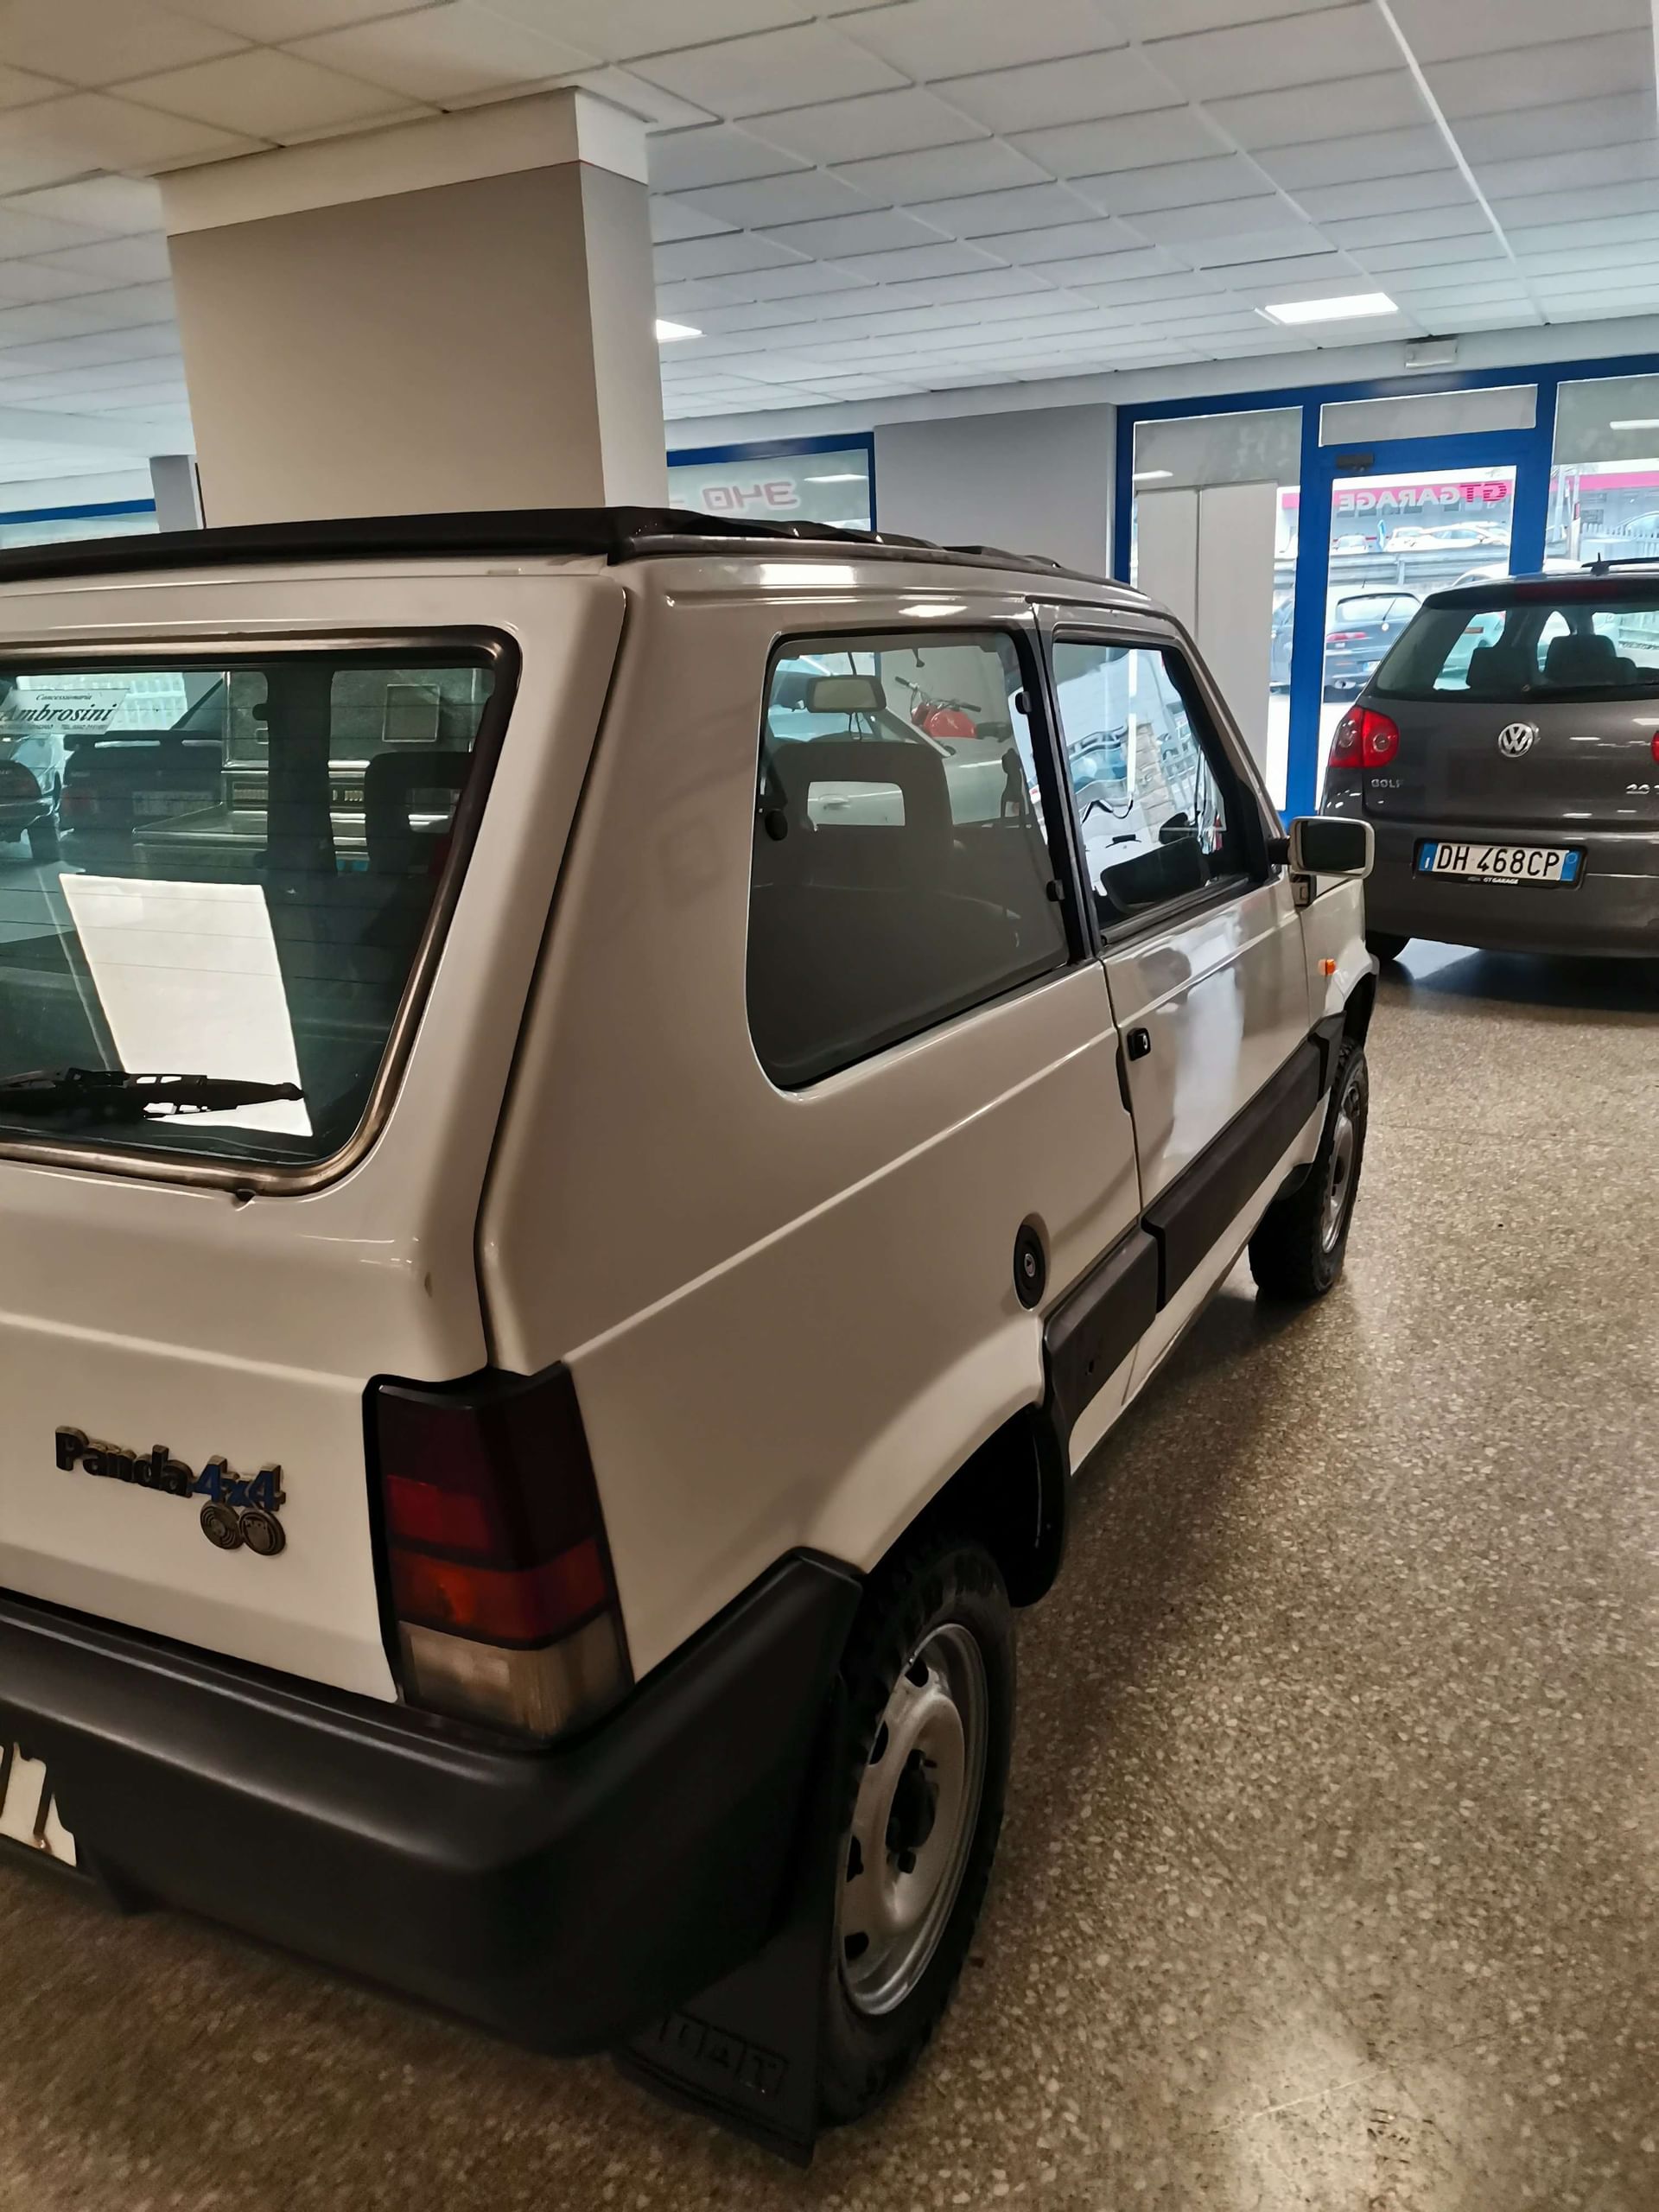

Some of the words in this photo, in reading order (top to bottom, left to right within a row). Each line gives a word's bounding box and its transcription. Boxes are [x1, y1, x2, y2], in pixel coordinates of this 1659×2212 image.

[1370, 779, 1402, 788] GOLF
[1436, 844, 1470, 871] DH
[1477, 848, 1560, 877] 468CP
[54, 1425, 195, 1498] Panda
[188, 1454, 287, 1513] 4x4
